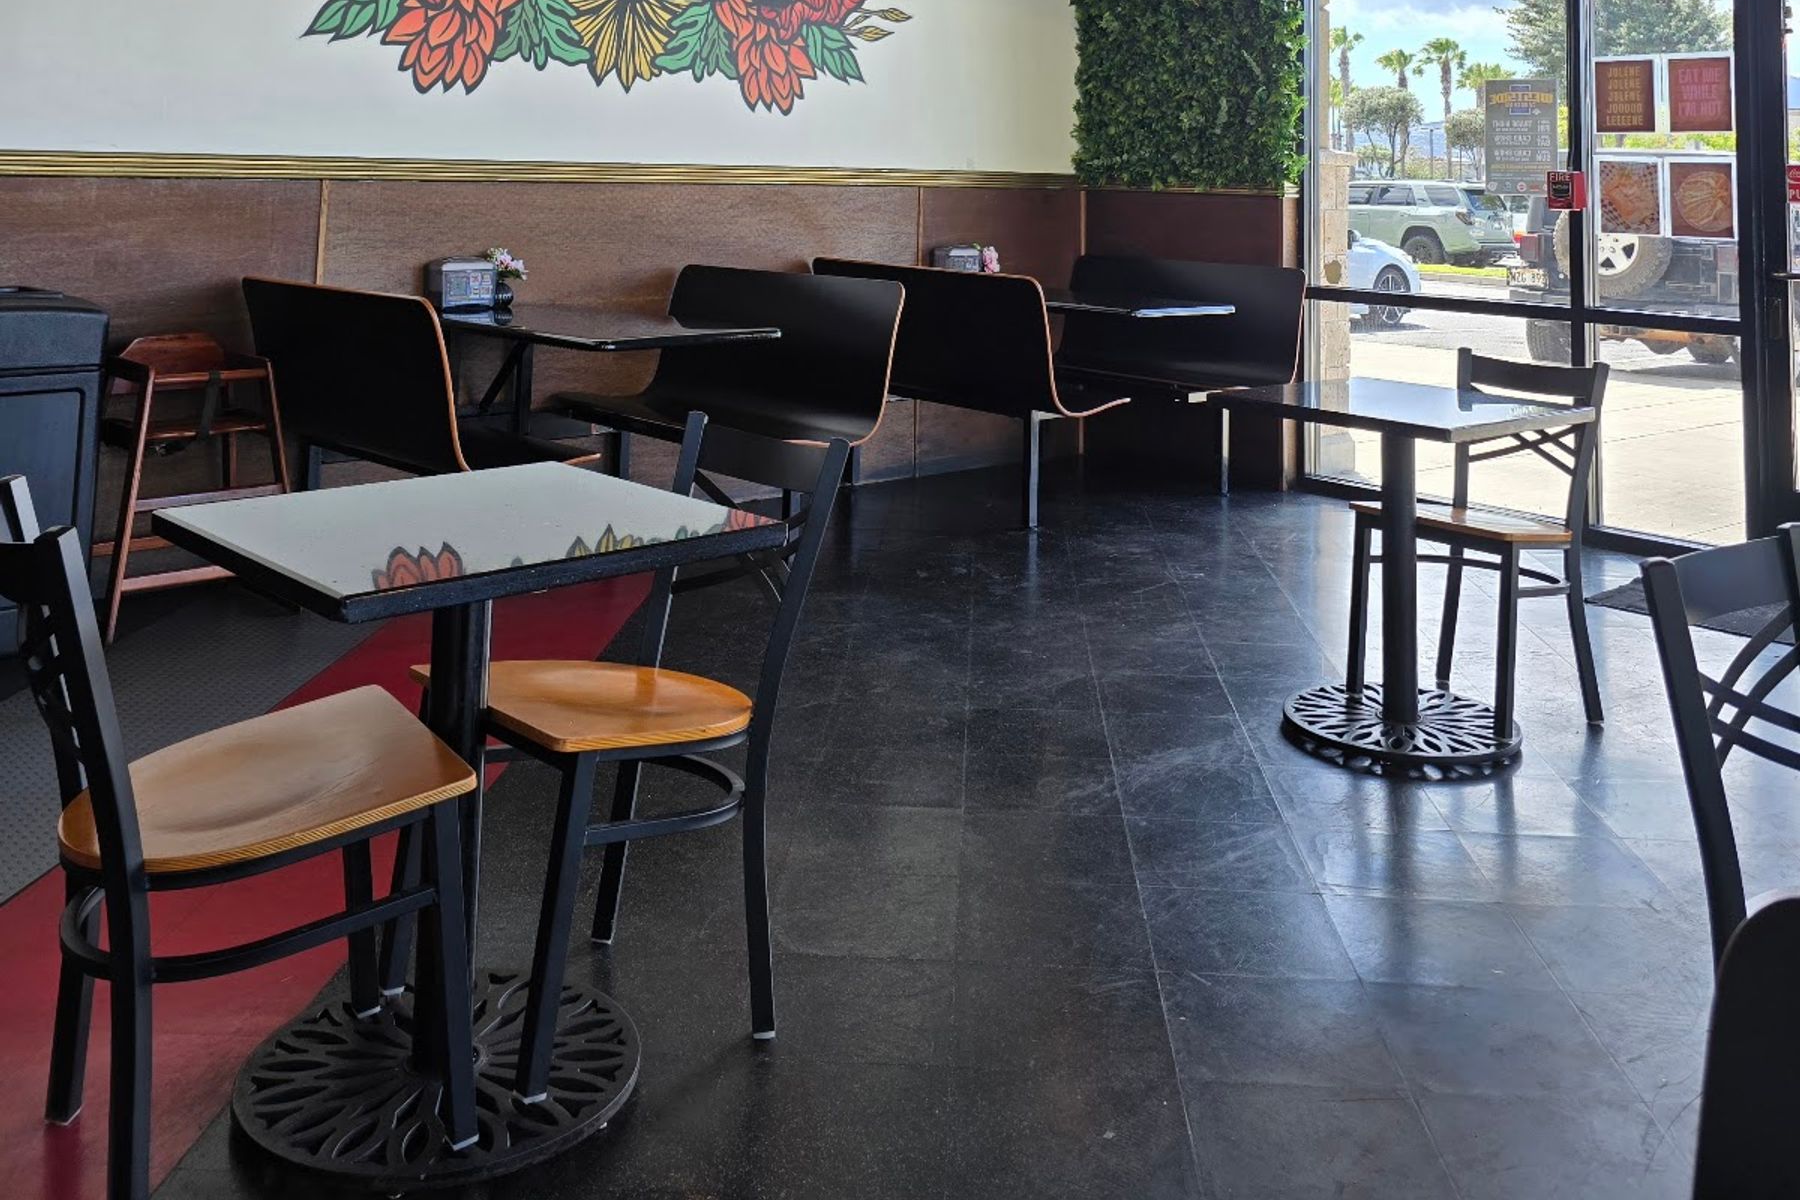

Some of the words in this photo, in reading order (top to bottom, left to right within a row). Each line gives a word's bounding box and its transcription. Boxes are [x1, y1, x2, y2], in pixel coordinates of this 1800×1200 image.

[1607, 66, 1641, 78] JOLENE
[1678, 68, 1698, 83] EAT
[1701, 67, 1721, 82] ME
[1607, 78, 1641, 90] JOLENE
[1607, 90, 1641, 102] JOLENE
[1700, 101, 1721, 116] HOT
[1550, 172, 1571, 182] FIRE
